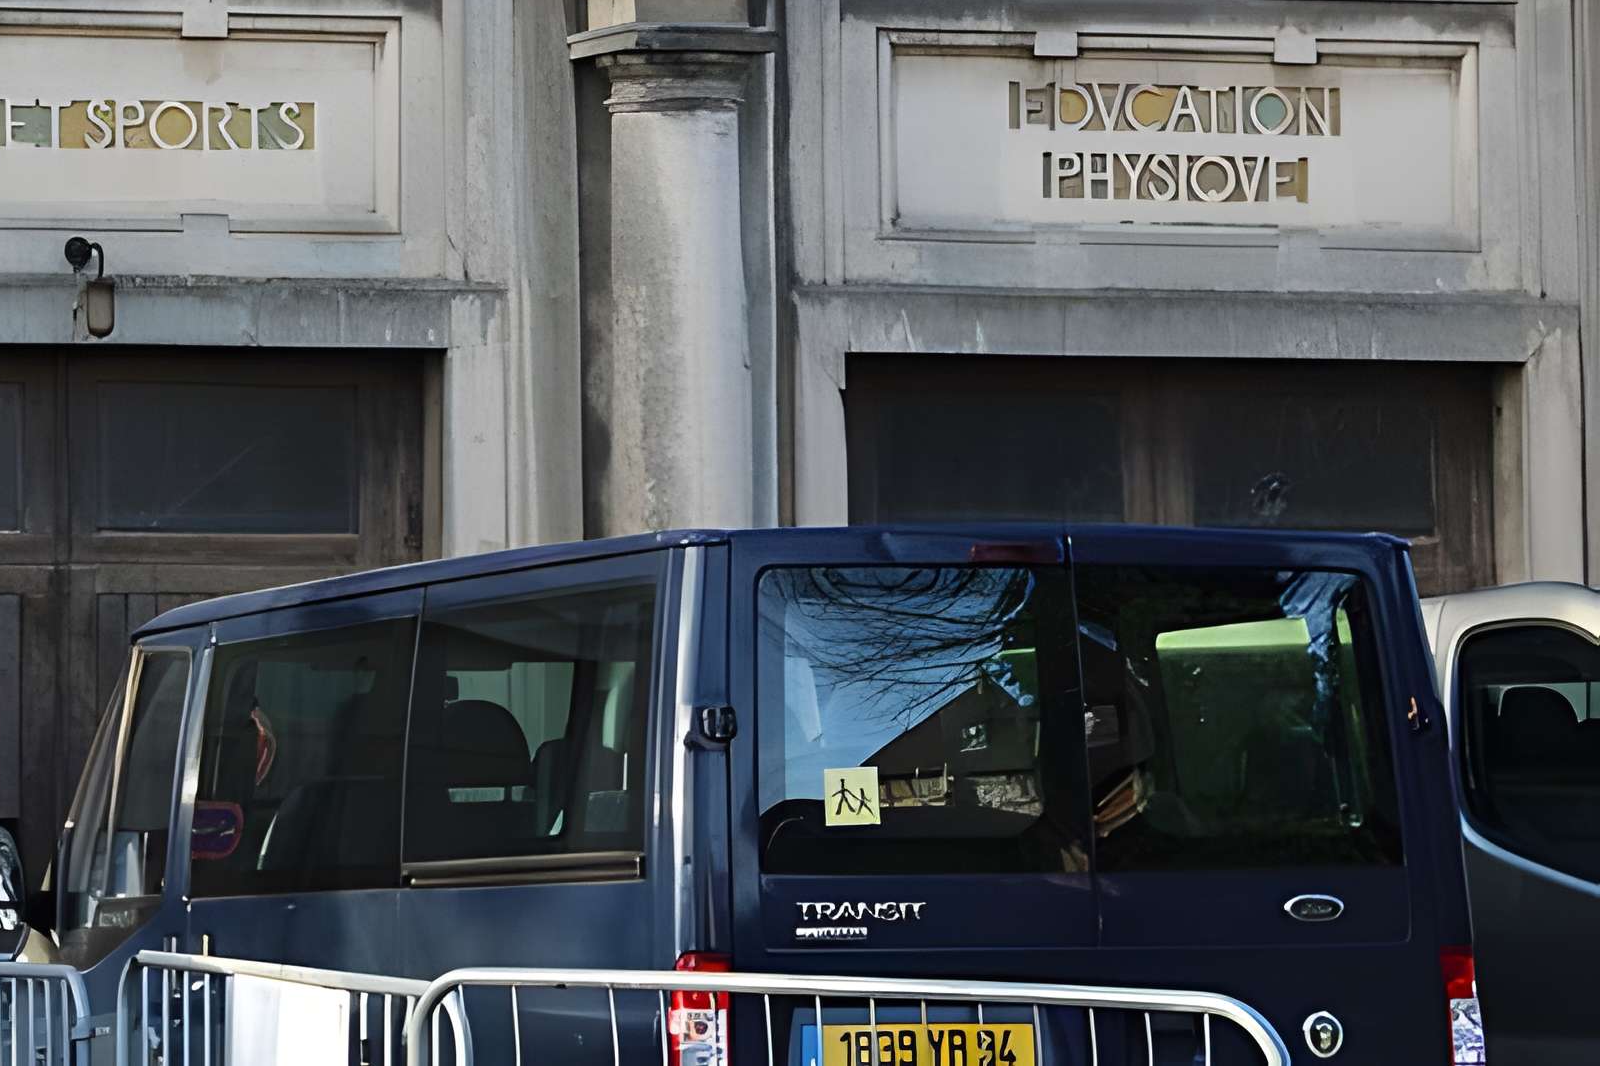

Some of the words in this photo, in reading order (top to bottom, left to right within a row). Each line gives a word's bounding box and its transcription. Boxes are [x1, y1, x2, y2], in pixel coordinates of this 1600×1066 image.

[4, 97, 74, 150] ET
[83, 99, 308, 152] SPORTS
[796, 901, 927, 920] TRANSIT
